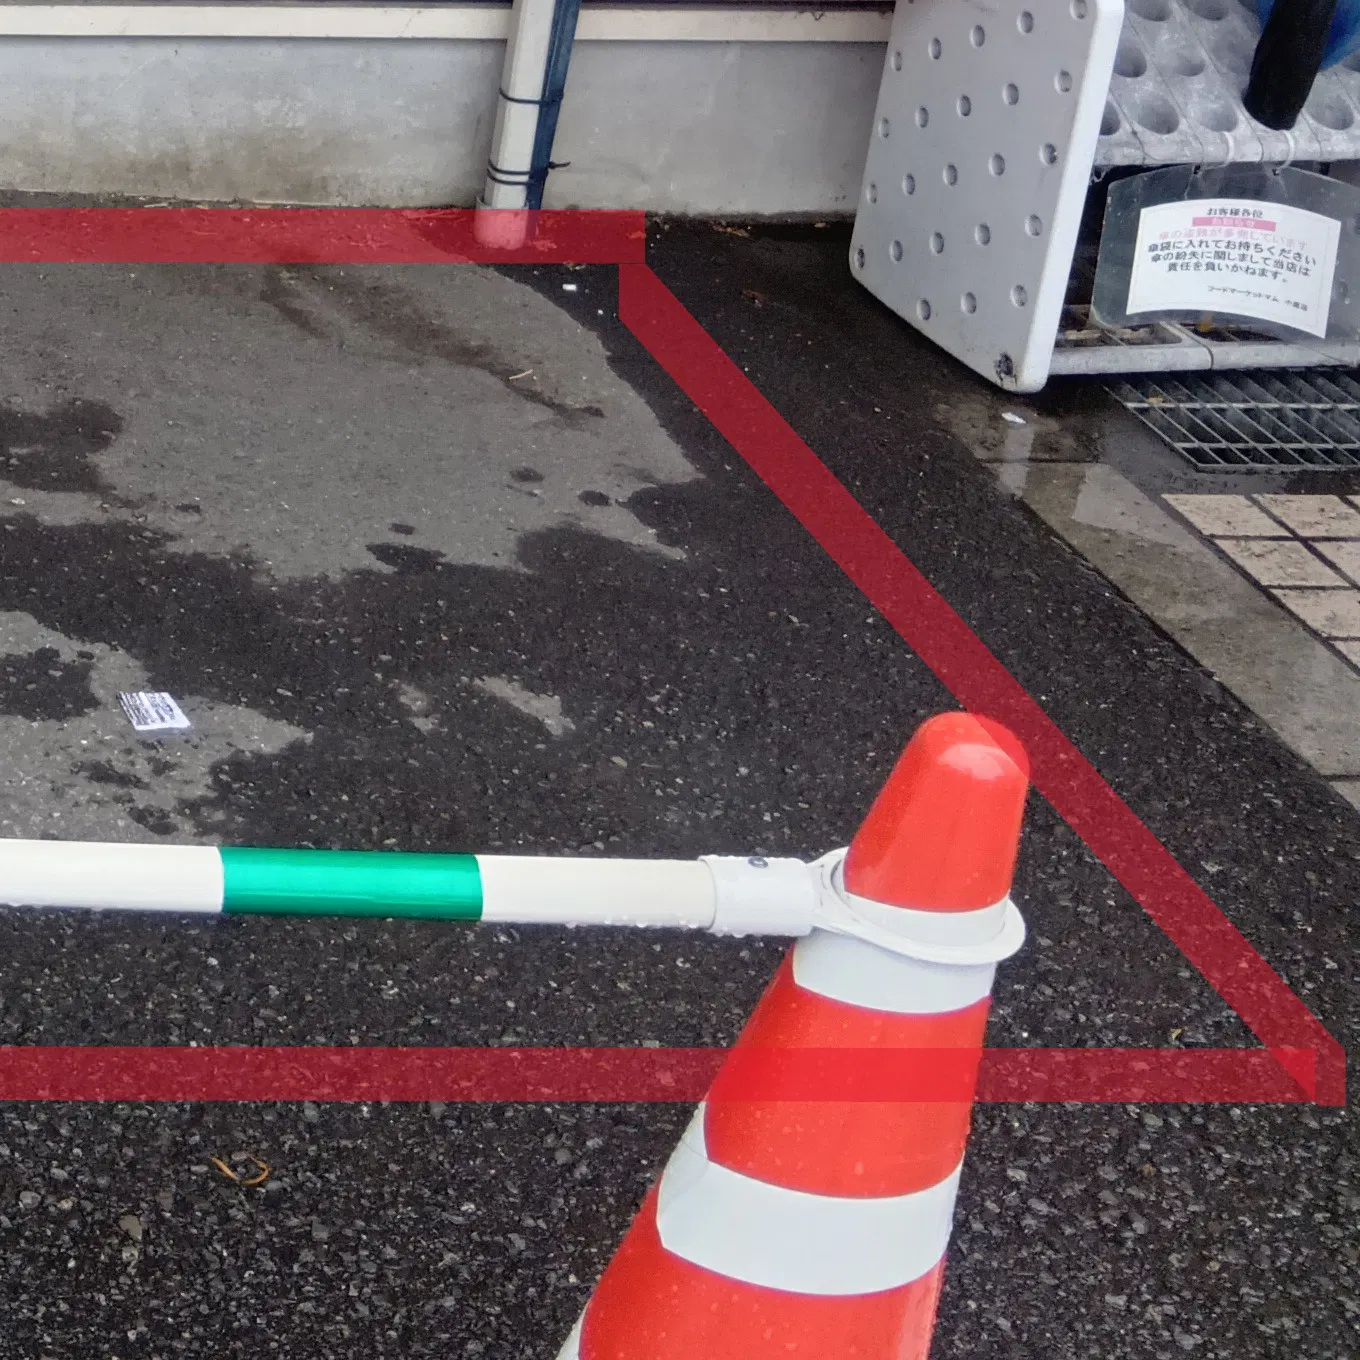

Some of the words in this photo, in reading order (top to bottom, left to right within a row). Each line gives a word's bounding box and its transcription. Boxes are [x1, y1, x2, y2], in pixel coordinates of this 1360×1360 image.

[1206, 206, 1264, 219] お客様各位
[1167, 261, 1289, 283] 責任を負いかねます。
